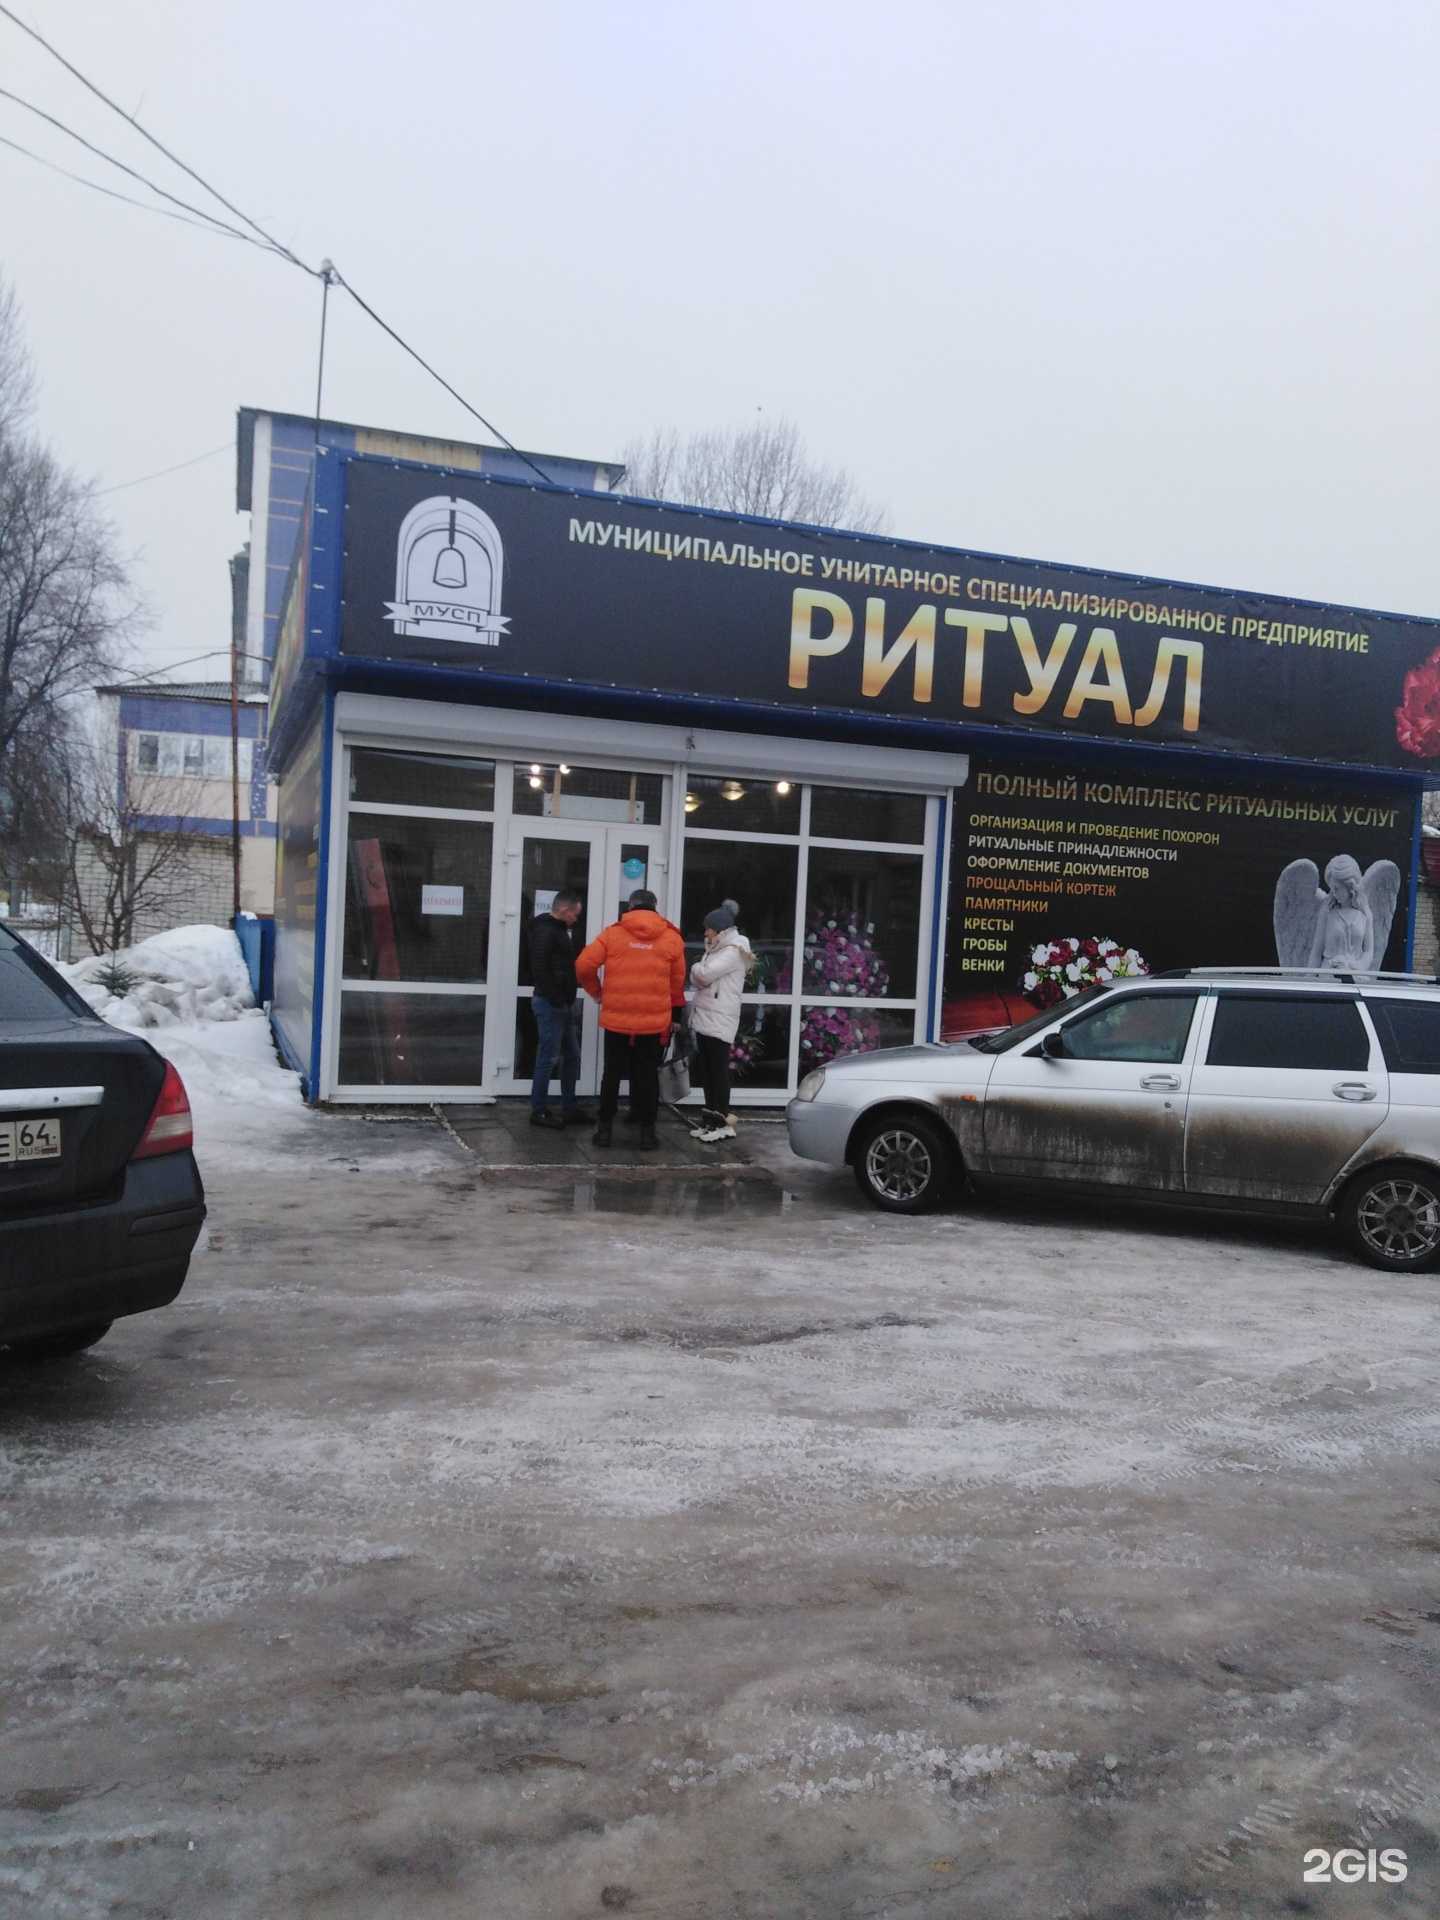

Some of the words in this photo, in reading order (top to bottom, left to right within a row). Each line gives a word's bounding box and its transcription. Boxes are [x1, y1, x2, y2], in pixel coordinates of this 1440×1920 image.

[569, 518, 814, 577] МУНИЦИПАЛЬНОЕ
[821, 555, 961, 597] УНИТАРНОЕ
[967, 577, 1226, 635] СПЕЦИАЛИЗИРОВАННОЕ
[1231, 616, 1369, 654] ПРЕДПРИЯТИЕ
[414, 605, 481, 623] МУСП
[788, 587, 1204, 732] РИТУАЛ
[977, 772, 1077, 800] ПОЛНЫЙ
[1084, 782, 1201, 811] КОМПЛЕКС
[1206, 793, 1337, 823] РИТУАЛЬНЫХ
[1343, 806, 1399, 828] УСЛУГ
[969, 814, 1063, 834] ОРГАНИЗАЦИЯ
[1066, 821, 1076, 834] И
[1079, 823, 1159, 841] ПРОВЕДЕНИЕ
[1162, 829, 1220, 845] ПОХОРОН
[968, 835, 1054, 852] РИТУАЛЬНЫЕ
[1057, 841, 1178, 862] ПРИНАДЛЕЖНОСТИ
[967, 855, 1061, 873] ОФОРМЛЕНИЕ
[1063, 862, 1150, 879] ДОКУМЕНТОВ
[966, 876, 1063, 894] ПРОЩАЛЬНЫЙ
[1066, 882, 1117, 897] КОРТЕЖ
[965, 897, 1049, 913] ПАМЯТНИКИ
[964, 917, 1014, 931] КРЕСТЫ
[962, 938, 1007, 952] ГРОБЫ
[962, 958, 1005, 972] ВЕНКИ
[20, 1123, 50, 1146] 64
